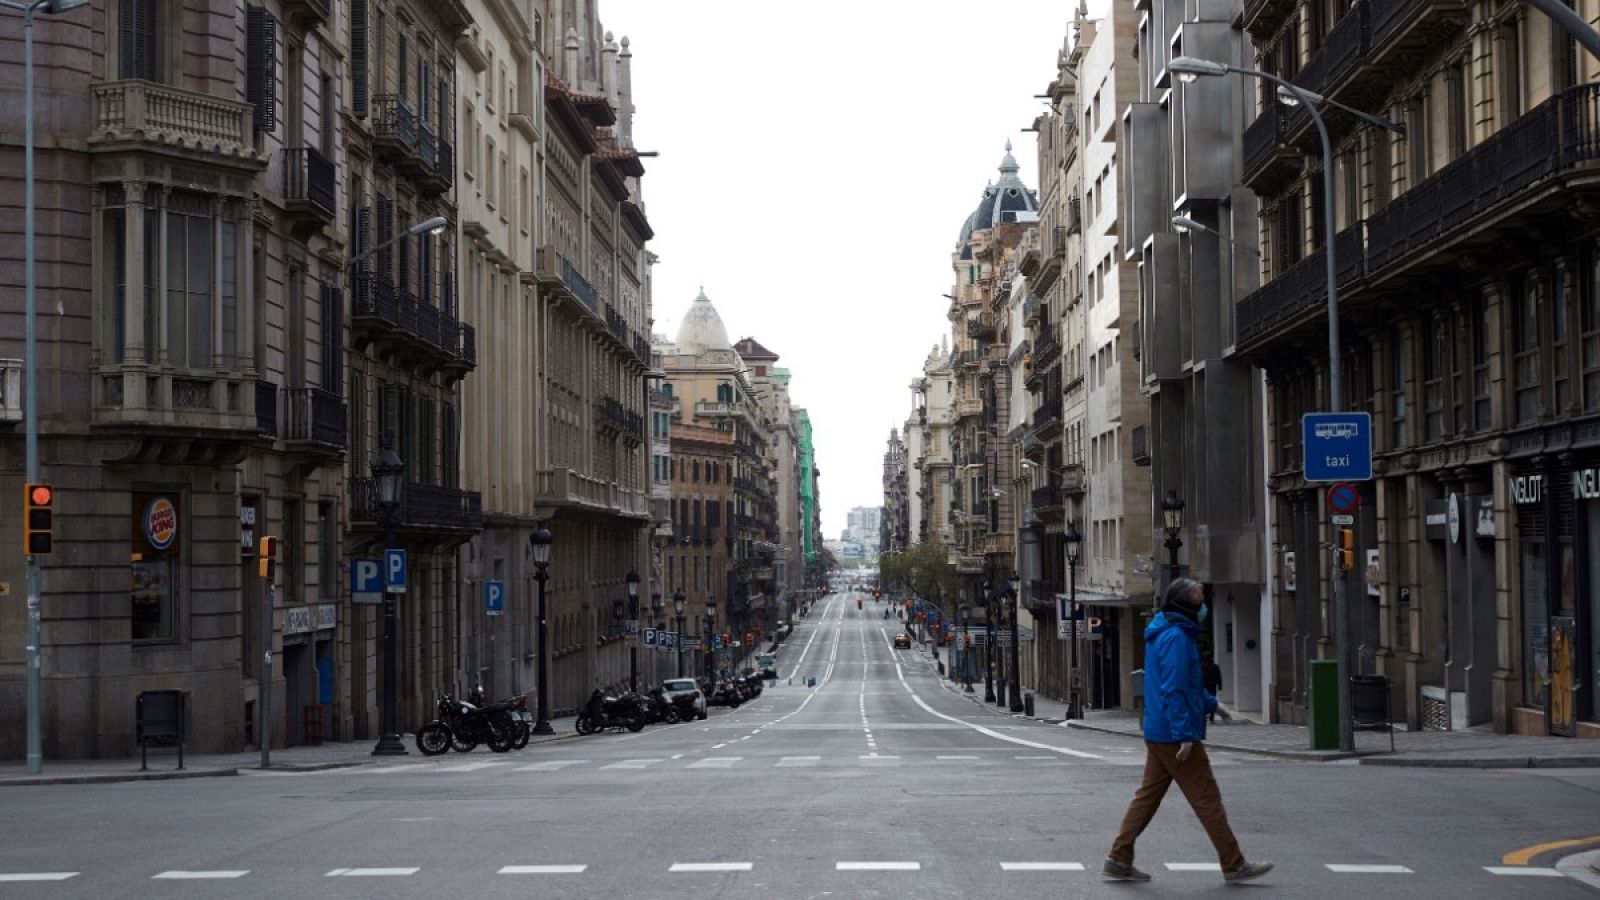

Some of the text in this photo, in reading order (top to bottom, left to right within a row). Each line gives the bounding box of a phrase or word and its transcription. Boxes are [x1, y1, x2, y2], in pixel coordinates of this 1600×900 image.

[1325, 454, 1350, 467] taxi
[1508, 475, 1542, 504] INGLOT
[150, 517, 174, 536] KING
[357, 561, 378, 591] P
[389, 554, 402, 582] P
[489, 585, 500, 607] P
[1401, 588, 1408, 600] P
[1088, 616, 1102, 632] P
[646, 631, 654, 643] P
